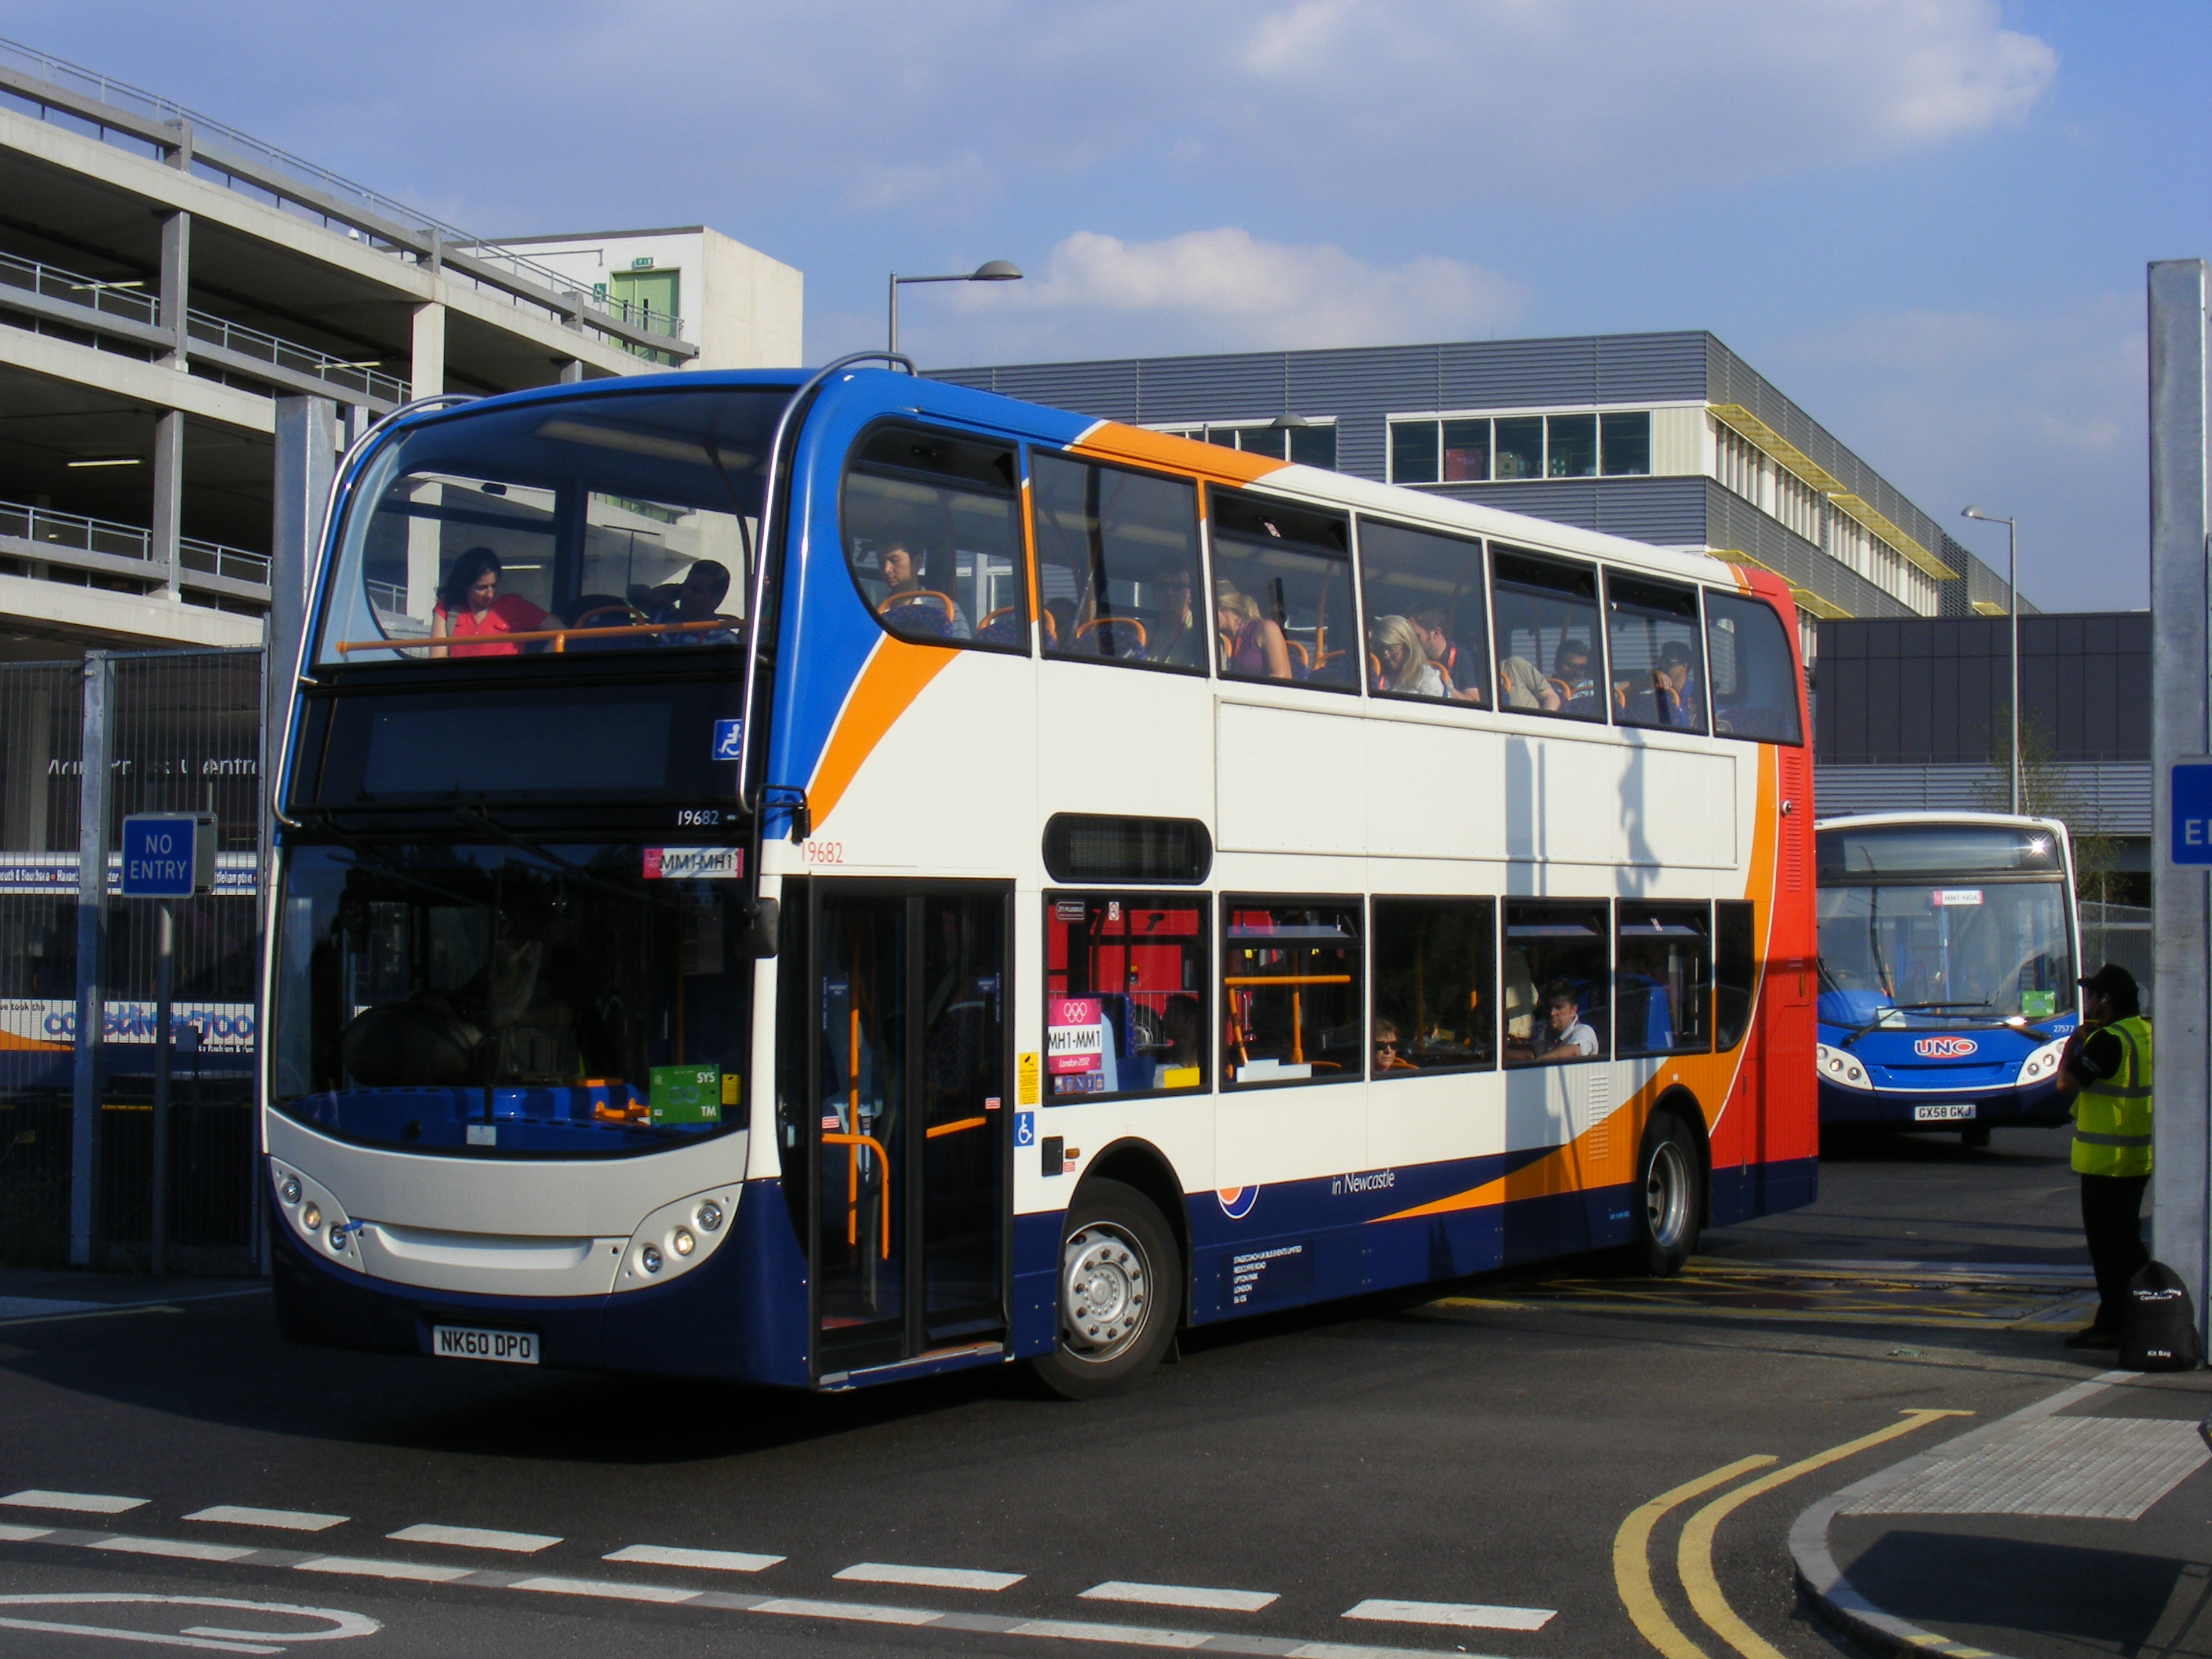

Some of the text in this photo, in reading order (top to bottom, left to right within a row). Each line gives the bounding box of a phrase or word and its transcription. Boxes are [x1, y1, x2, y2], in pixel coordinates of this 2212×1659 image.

[678, 811, 718, 825] 19682
[2184, 819, 2212, 845] E
[145, 834, 172, 855] NO
[800, 841, 843, 863] 19682
[130, 860, 187, 880] ENTRY
[659, 854, 733, 869] MM1-MH1
[1048, 1031, 1100, 1049] MH1-MM1
[1914, 1038, 1978, 1057] UNO
[1059, 1058, 1078, 1067] London
[697, 1072, 716, 1084] SYS
[701, 1105, 717, 1117] TM
[1919, 1106, 1971, 1118] GX58 GKJ
[1332, 1168, 1395, 1195] in Newcastle
[441, 1330, 531, 1358] NK60 DPO
